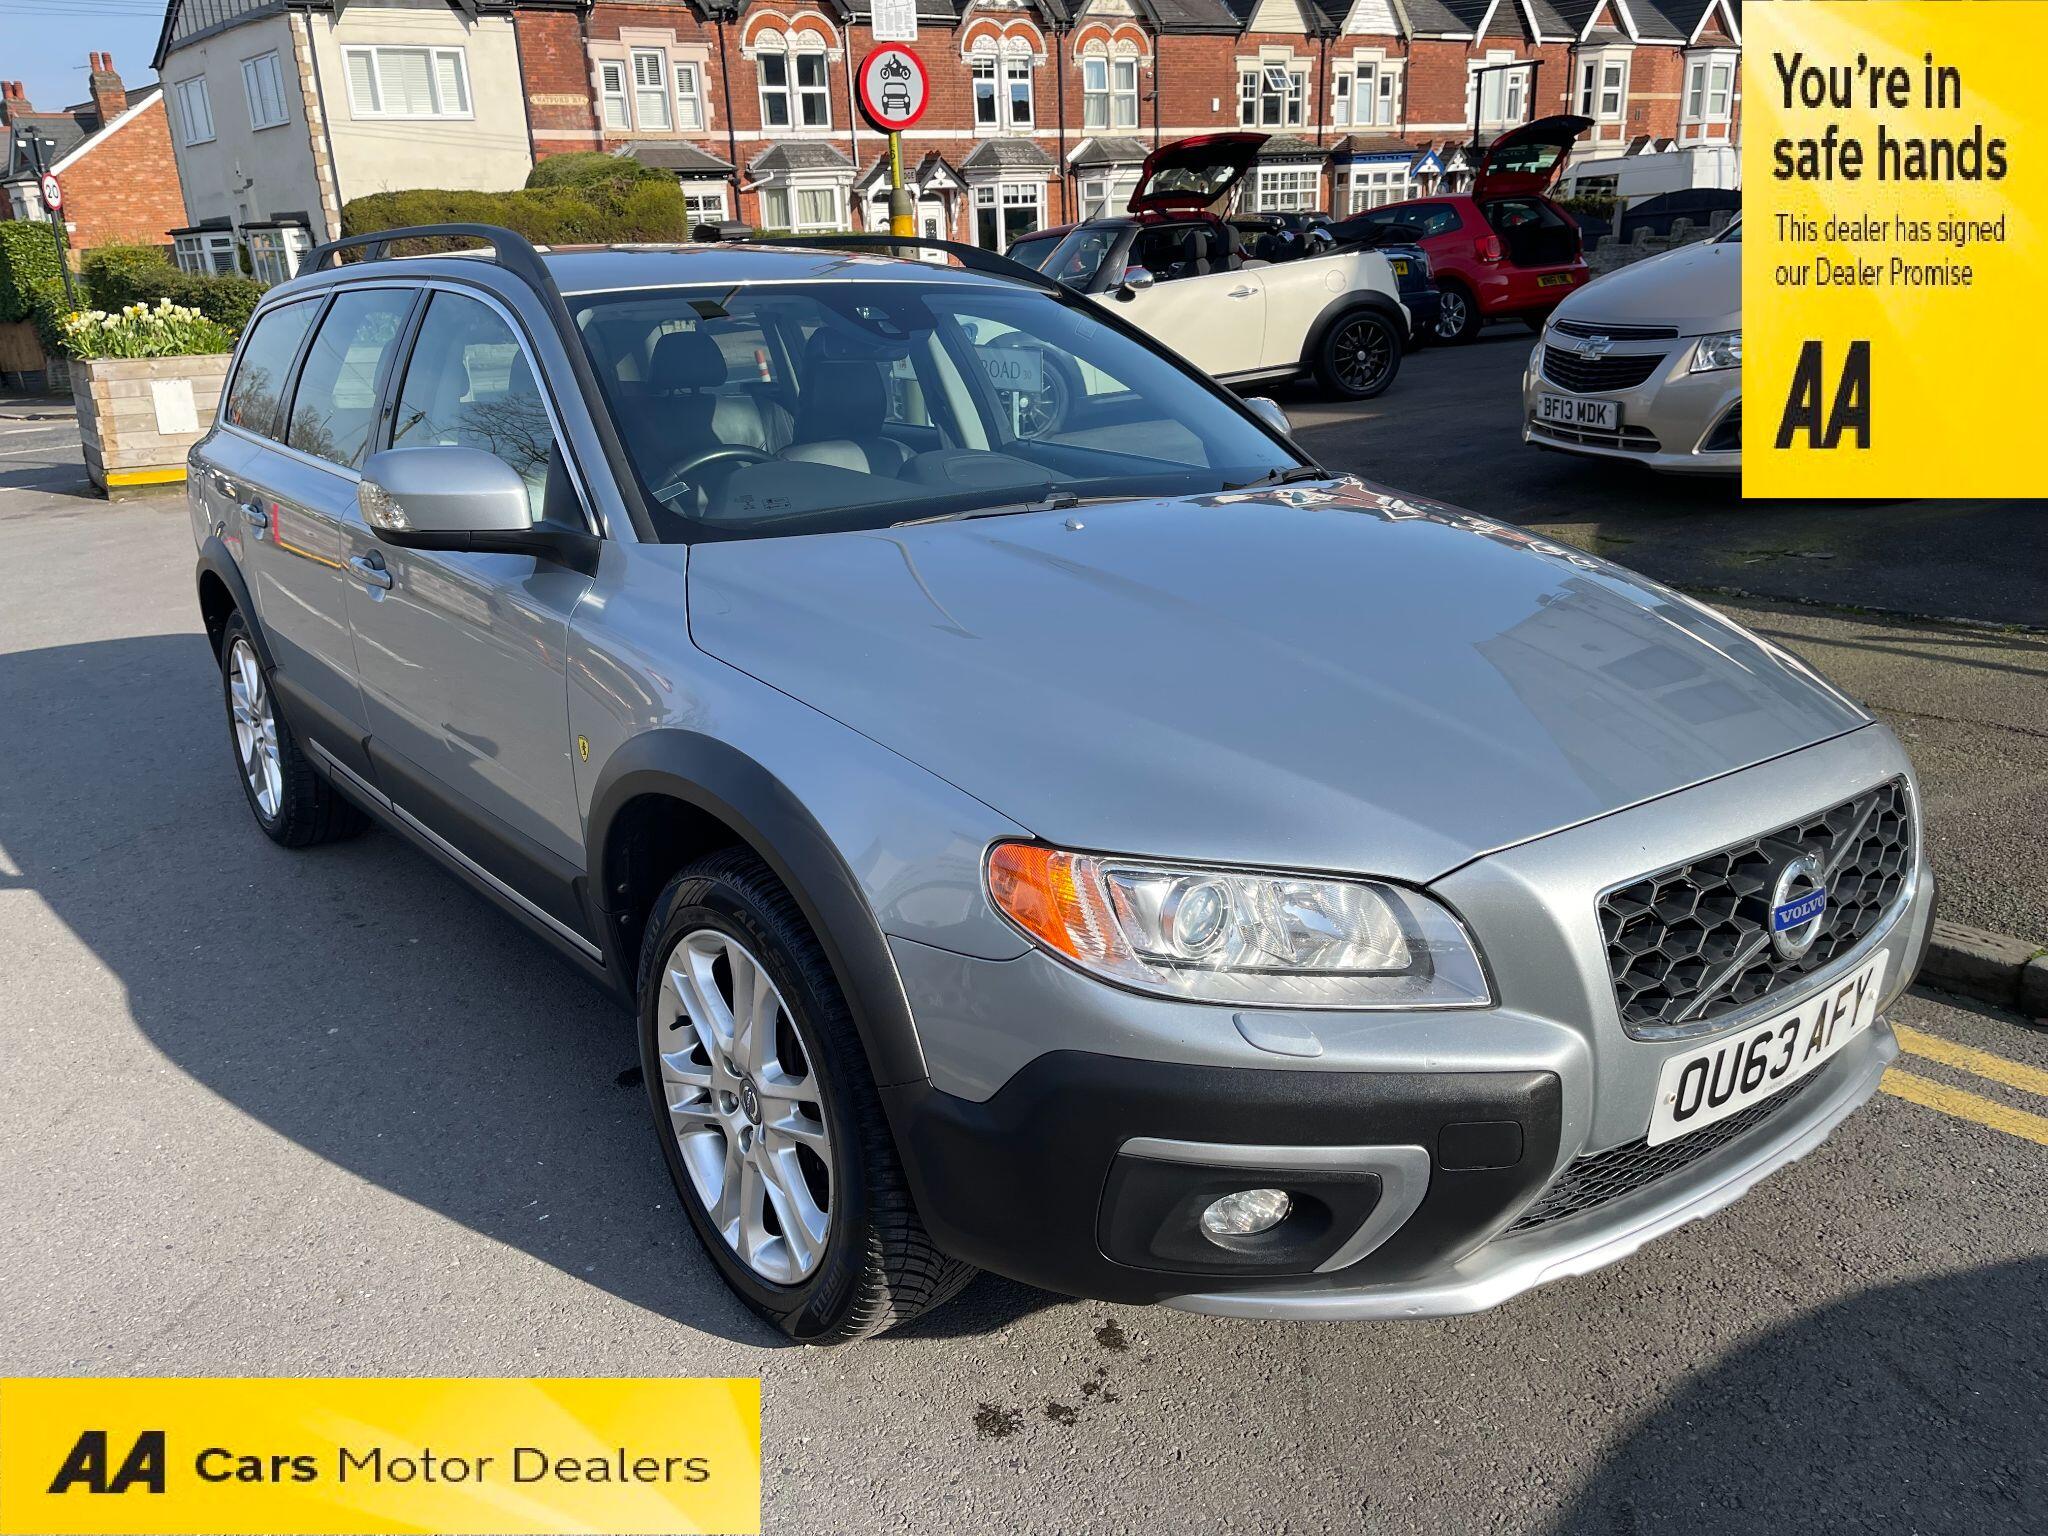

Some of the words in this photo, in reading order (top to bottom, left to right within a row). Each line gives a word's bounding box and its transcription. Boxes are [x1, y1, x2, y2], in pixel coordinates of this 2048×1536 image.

[45, 184, 59, 199] 20
[1544, 397, 1573, 420] BF13
[1577, 401, 1607, 425] MDK
[1779, 894, 1825, 924] VOLVO
[1673, 1016, 1801, 1122] OU63
[1803, 967, 1874, 1062] AFY
